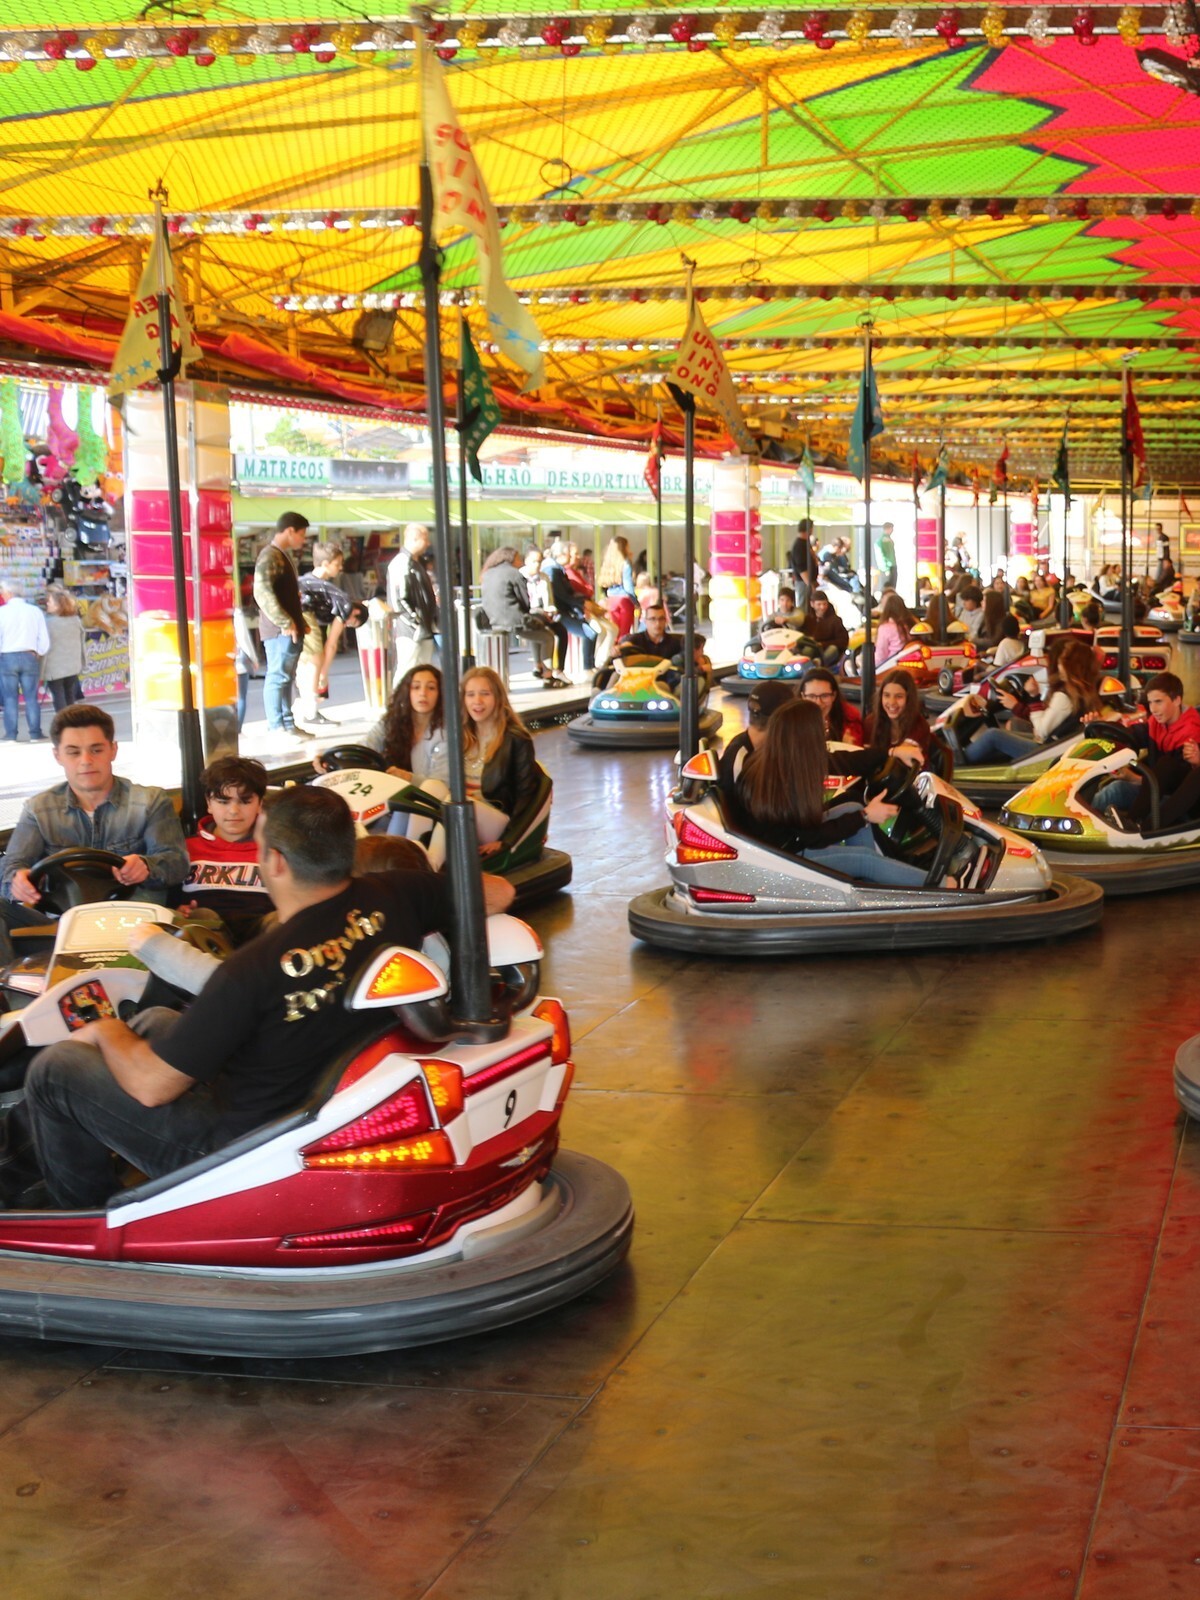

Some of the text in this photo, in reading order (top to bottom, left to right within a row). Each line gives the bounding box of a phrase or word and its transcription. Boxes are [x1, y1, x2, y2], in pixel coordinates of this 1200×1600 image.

[243, 458, 324, 480] MATRECOS
[348, 782, 374, 797] 24
[504, 1089, 517, 1129] 9
